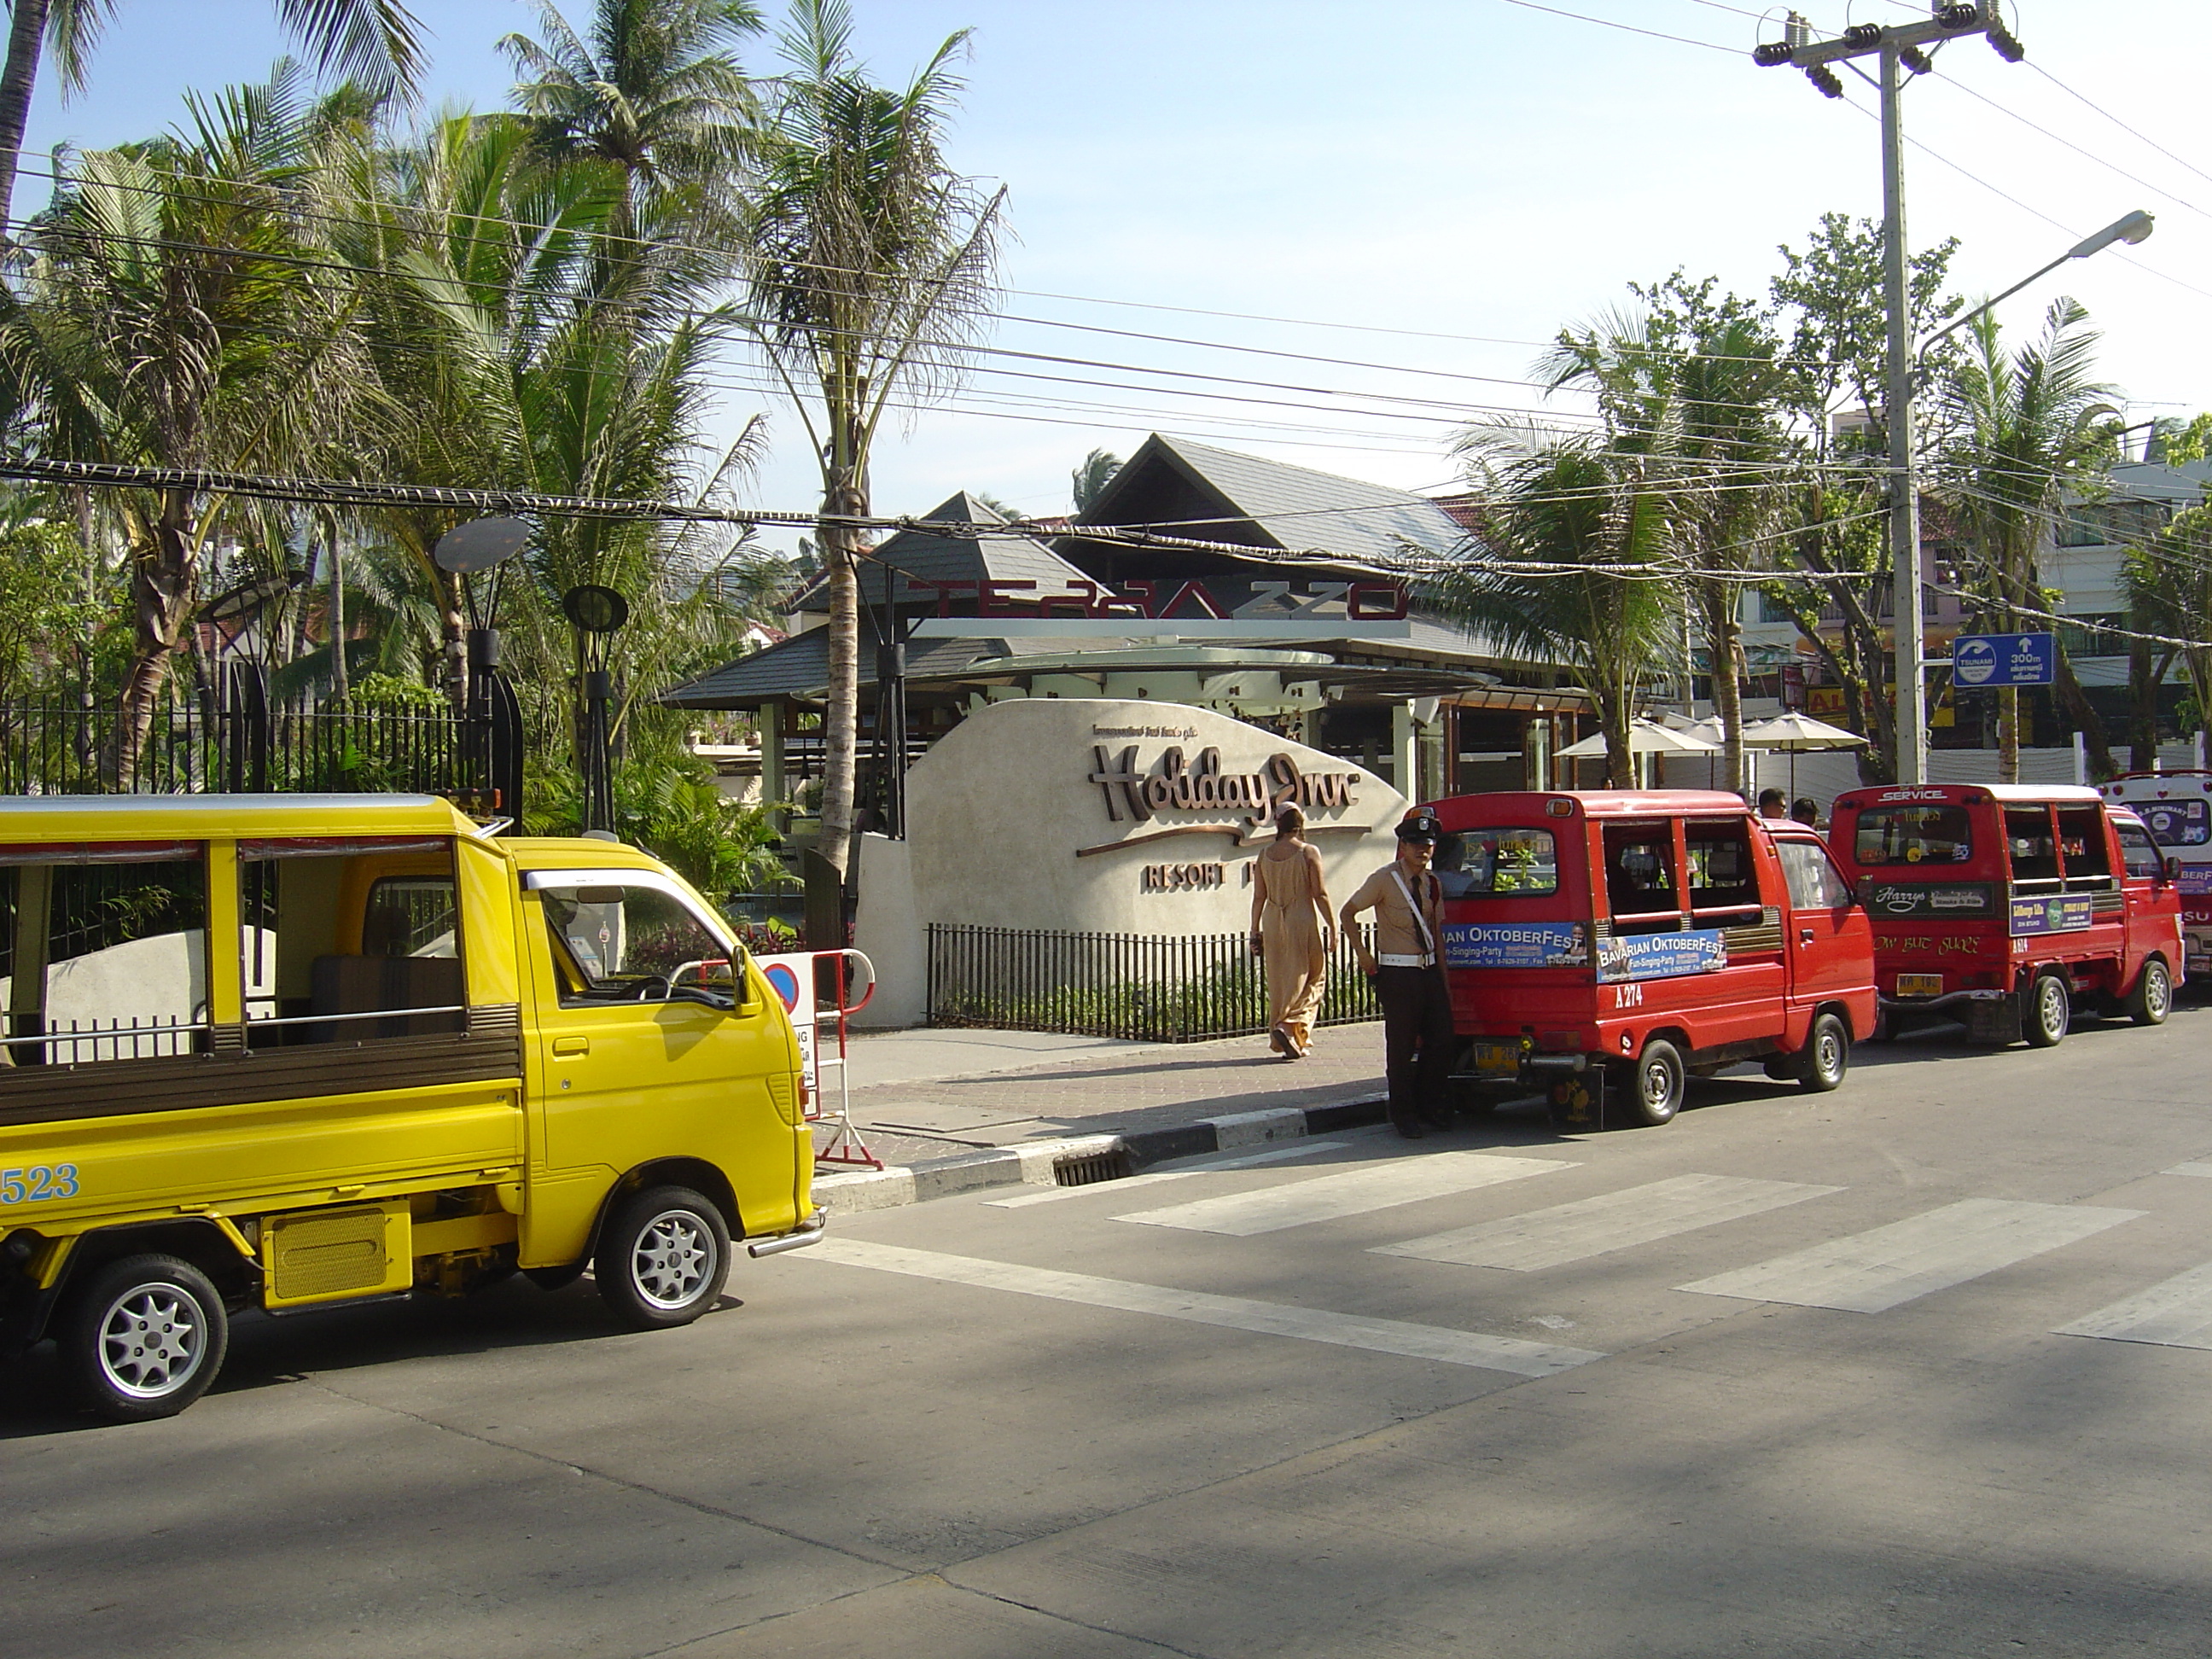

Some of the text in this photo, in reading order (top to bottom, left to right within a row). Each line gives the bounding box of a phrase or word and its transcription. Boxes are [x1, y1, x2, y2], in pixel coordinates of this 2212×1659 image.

[906, 579, 1408, 621] TERRAZZO
[1960, 658, 1994, 667] TSUNAMI
[2011, 654, 2041, 664] 300m
[1088, 745, 1360, 827] Holiday Inn
[1877, 789, 1948, 802] SERVICE
[1146, 862, 1230, 888] RESORT
[1875, 886, 1926, 913] Harrys
[1599, 940, 1650, 968] BAVARIAN
[1901, 937, 1932, 953] BUT
[1938, 937, 1980, 956] SURE
[1624, 985, 1643, 1007] 274
[1, 1163, 80, 1205] 523
